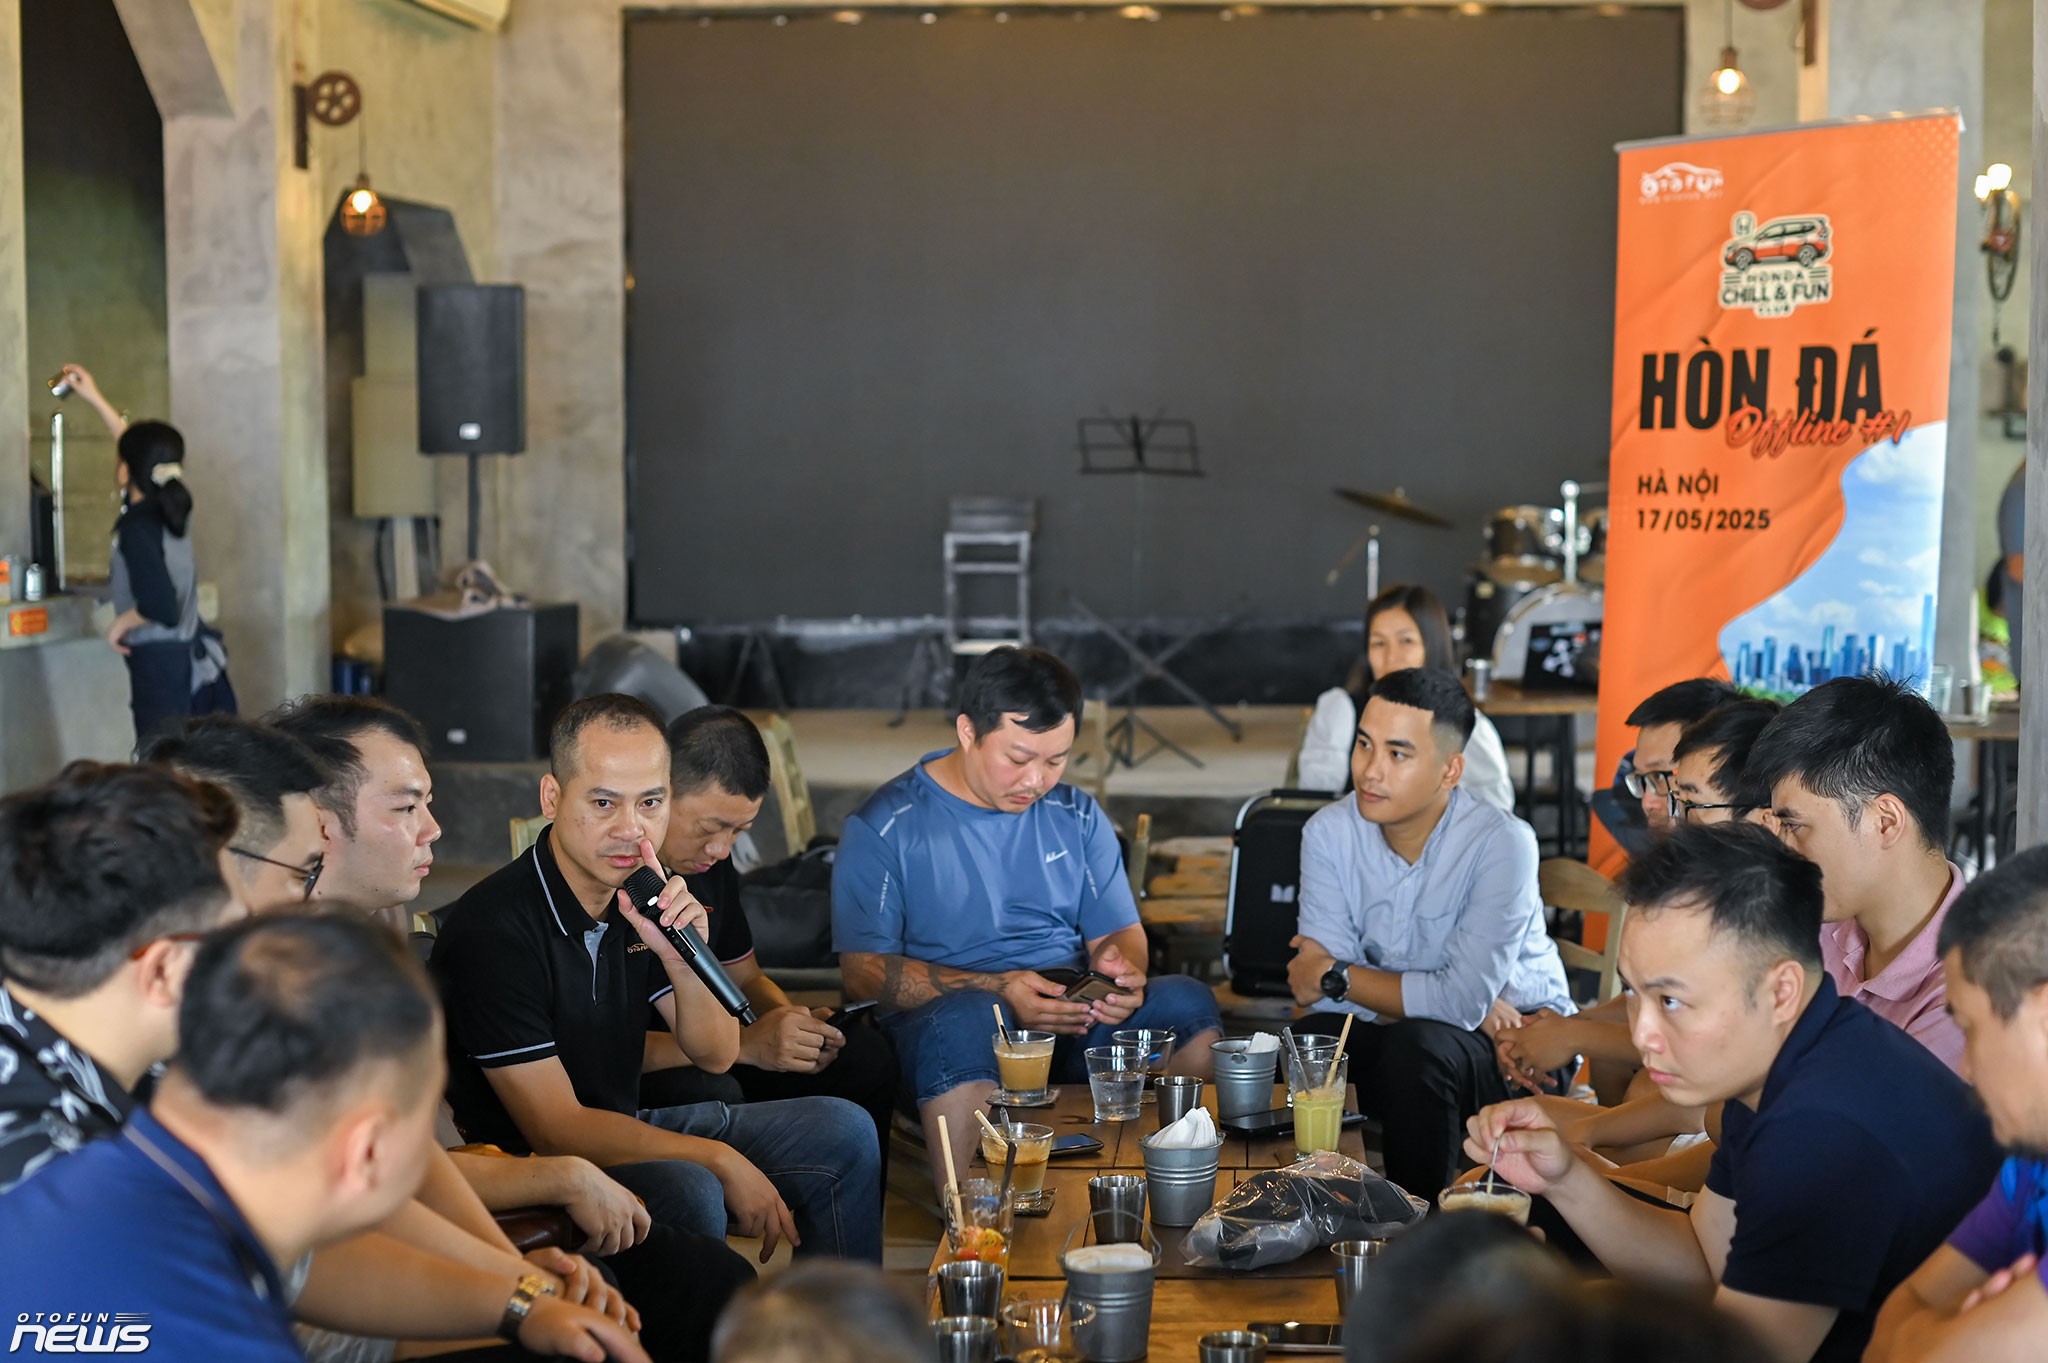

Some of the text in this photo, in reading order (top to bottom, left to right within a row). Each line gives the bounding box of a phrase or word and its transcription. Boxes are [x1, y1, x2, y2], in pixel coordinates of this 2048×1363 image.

[1723, 283, 1828, 304] CHILL & FUN
[1639, 327, 1883, 430] HÒN ĐÁ
[1725, 404, 1911, 459] Offline #1
[1637, 468, 1719, 502] HÀ NỘI
[1637, 509, 1771, 533] 17/05/2025
